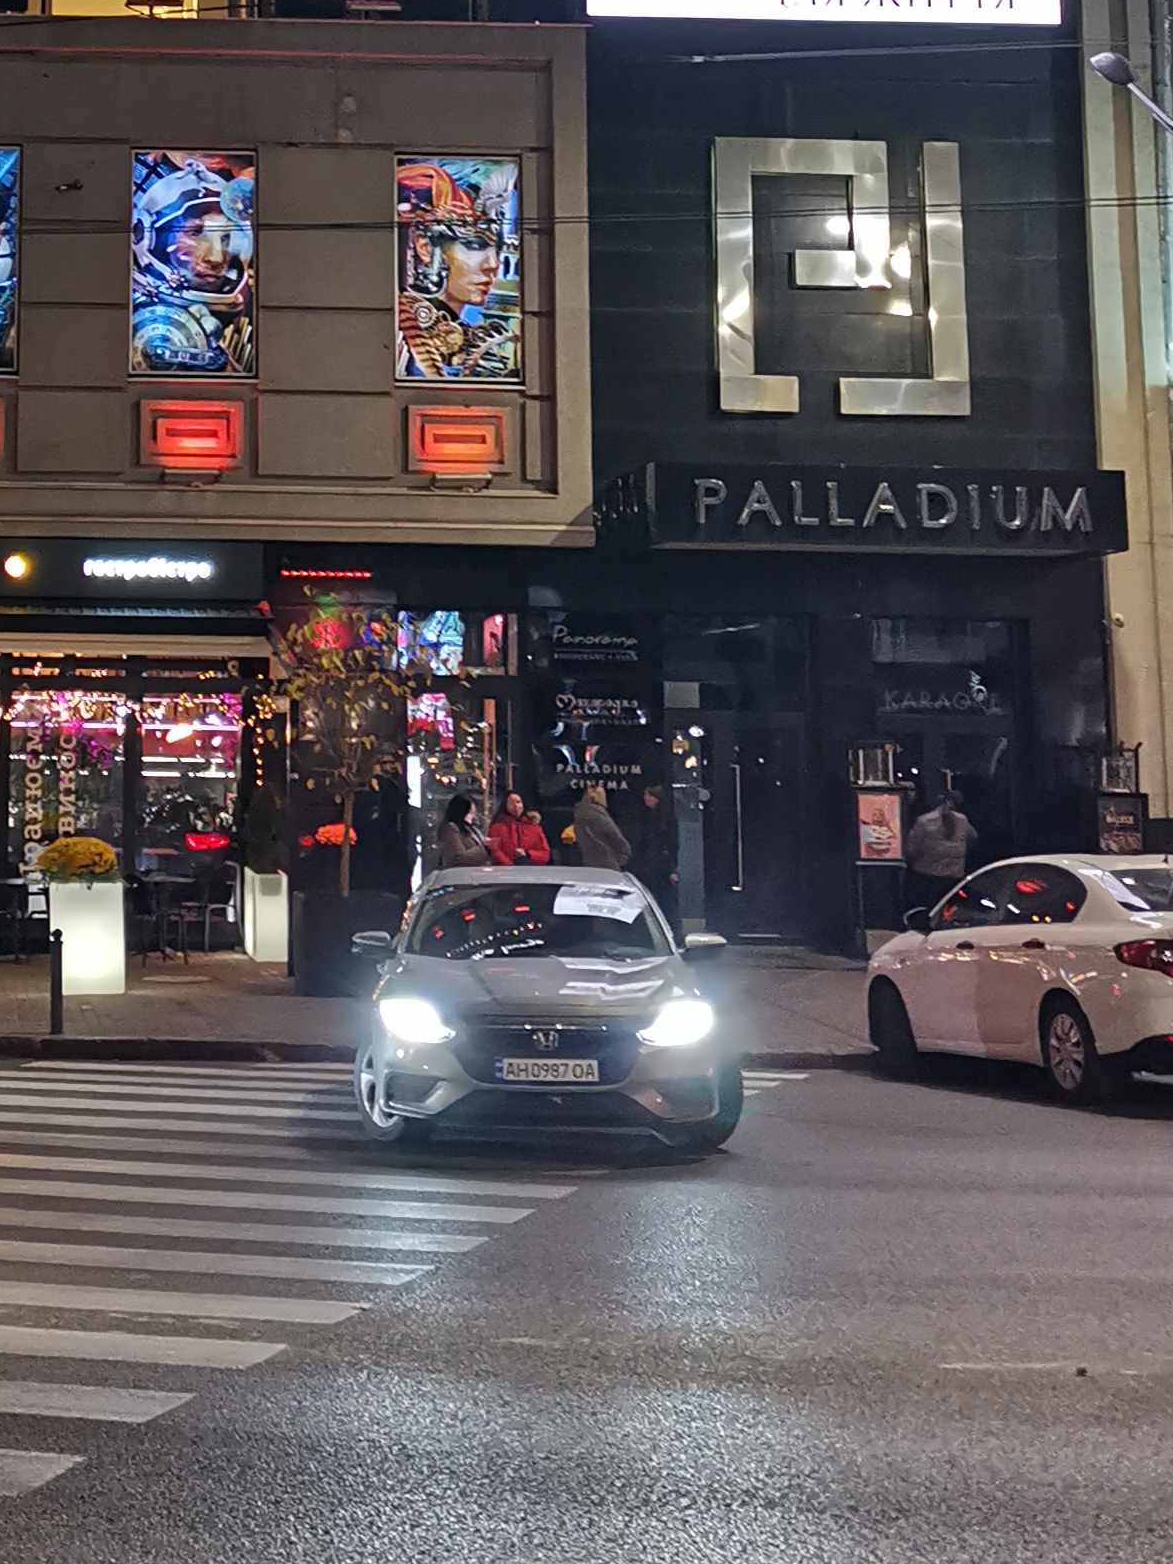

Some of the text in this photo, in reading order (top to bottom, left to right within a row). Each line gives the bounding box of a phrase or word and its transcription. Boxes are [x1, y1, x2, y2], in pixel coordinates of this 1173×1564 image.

[694, 477, 1094, 534] PALLADIUM
[58, 735, 77, 837] винос
[556, 763, 643, 776] PALLADIUM
